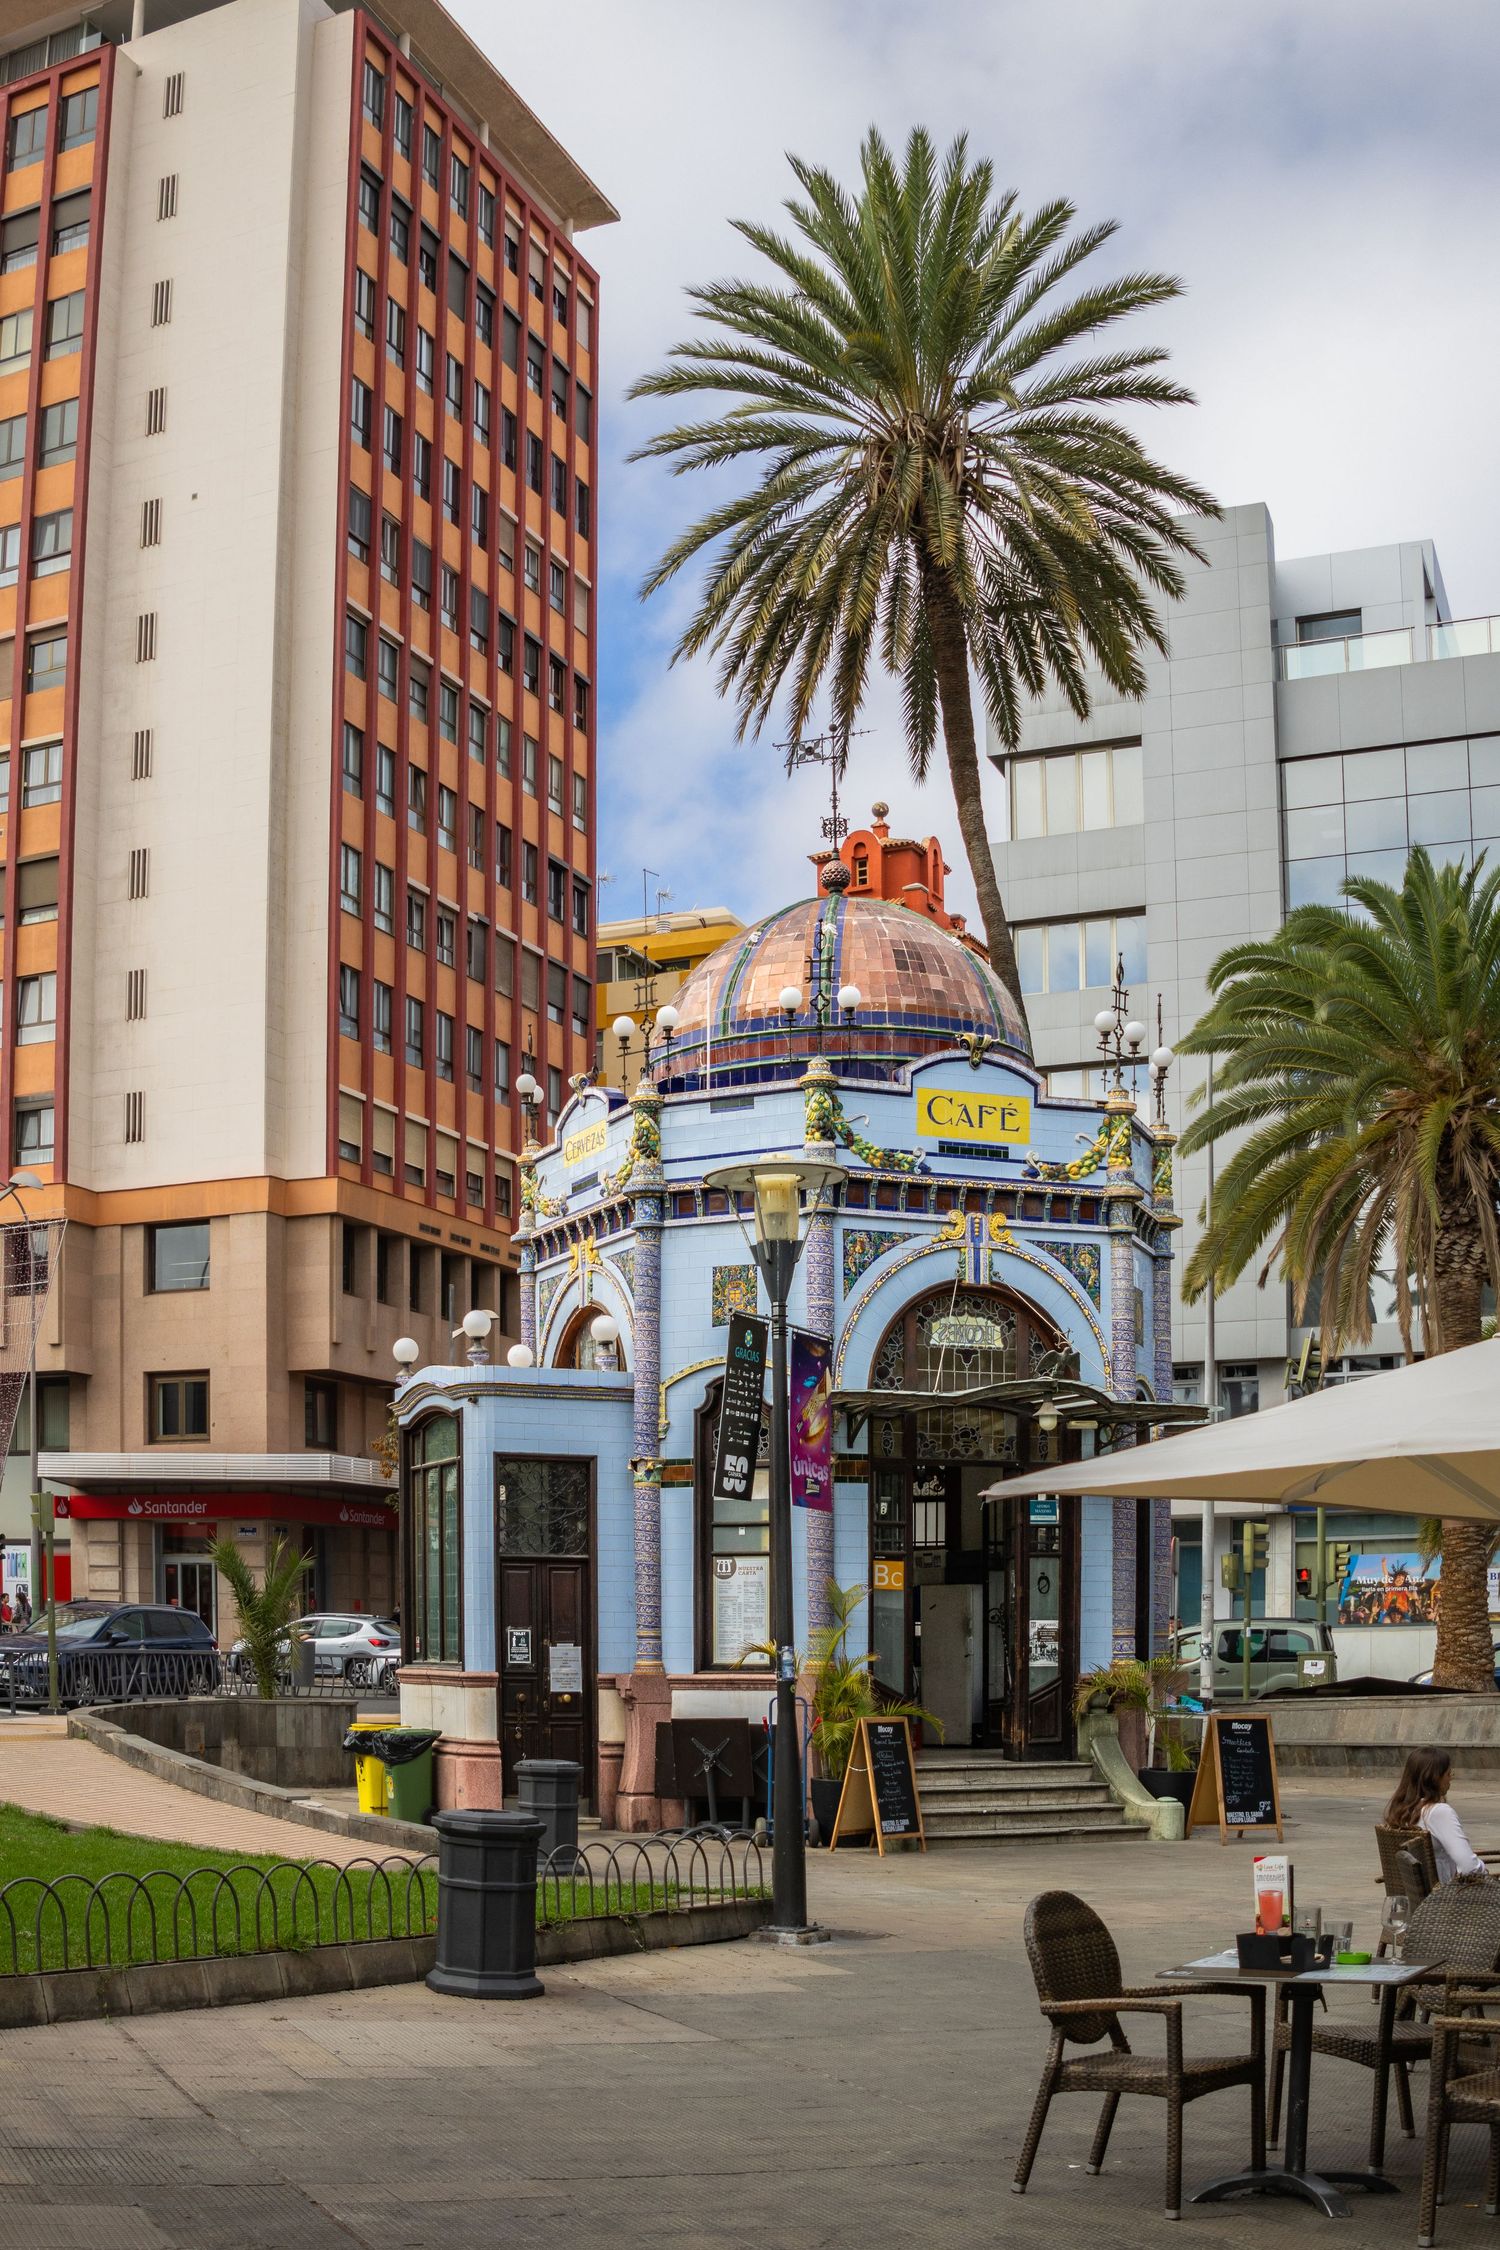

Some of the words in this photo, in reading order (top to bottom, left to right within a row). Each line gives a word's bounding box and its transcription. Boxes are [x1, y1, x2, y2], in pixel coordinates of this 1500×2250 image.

[926, 1095, 1020, 1132] CAFÉ
[566, 1128, 606, 1162] CERVEZAS
[735, 1346, 760, 1363] GRACIAS
[793, 1454, 829, 1481] únicas
[144, 1500, 208, 1514] Santander
[349, 1509, 386, 1526] Santander
[1356, 1575, 1379, 1586] Muy
[1382, 1574, 1394, 1584] de
